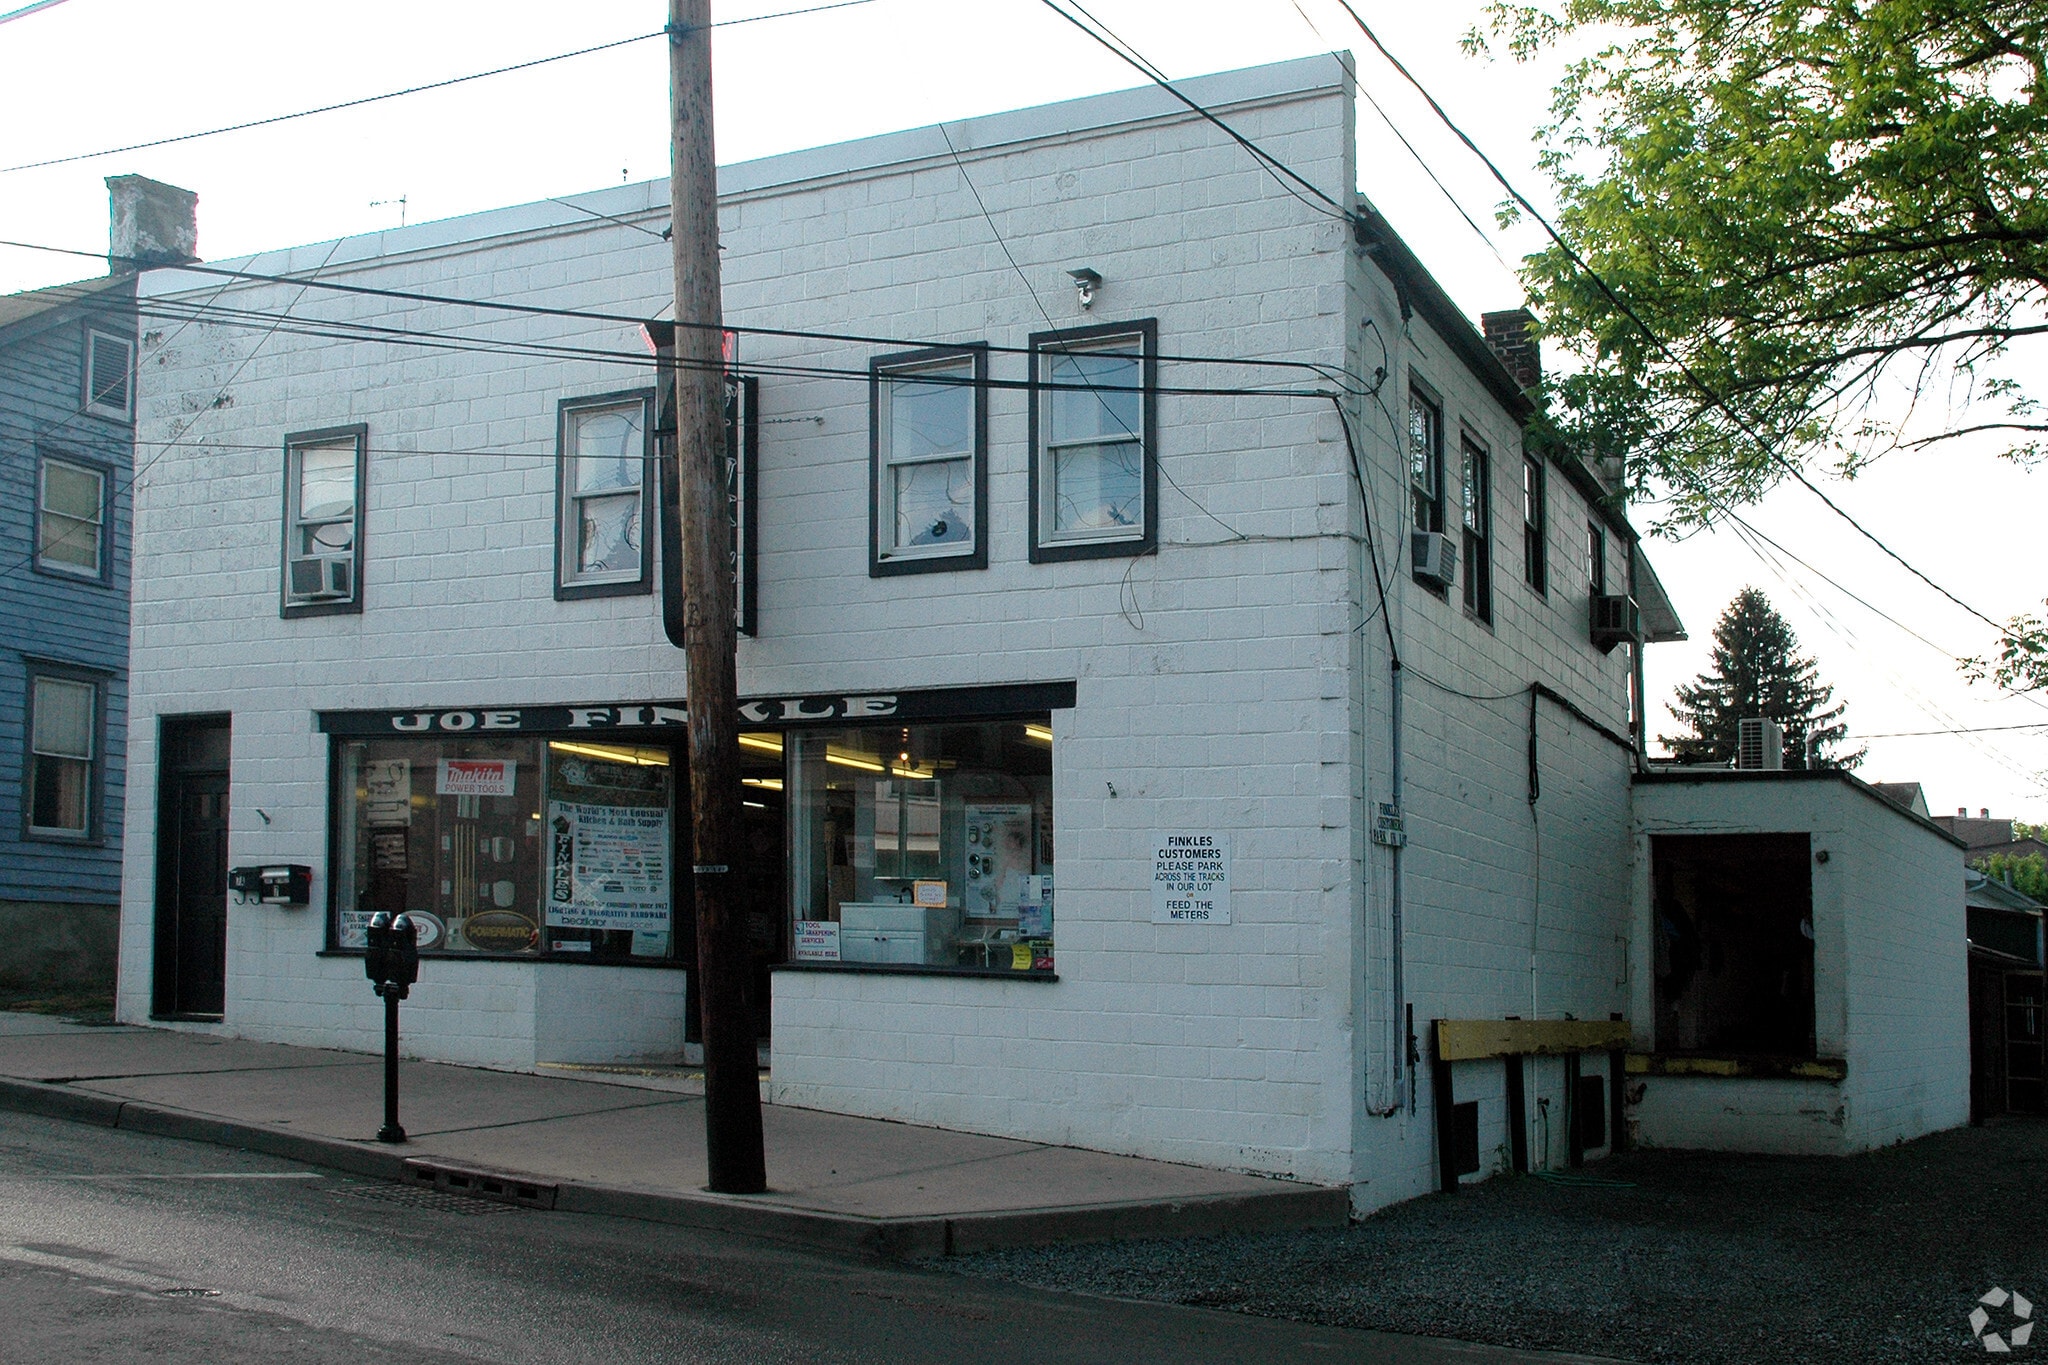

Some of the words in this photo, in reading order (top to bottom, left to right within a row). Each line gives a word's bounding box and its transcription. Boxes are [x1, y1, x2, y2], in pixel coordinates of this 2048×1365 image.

[392, 710, 521, 731] JOE
[448, 767, 502, 784] Makita
[444, 783, 475, 793] POWER
[477, 784, 505, 794] TOOLS
[559, 803, 573, 813] The
[608, 808, 627, 817] Most
[578, 815, 607, 825] Kitchen
[617, 818, 636, 826] Bath
[637, 819, 663, 828] Supply
[1168, 836, 1213, 846] FINKLES
[1373, 829, 1387, 843] PARK
[1158, 849, 1221, 859] CUSTOMERS
[554, 834, 570, 900] FINKLES
[1156, 861, 1194, 871] PLEASE
[1197, 861, 1223, 871] PARK
[1155, 872, 1181, 881] ACROSS
[1183, 872, 1196, 881] THE
[1199, 872, 1225, 881] TRACKS
[1166, 882, 1174, 891] IN
[1177, 882, 1195, 891] OUR
[1197, 882, 1213, 891] LOT
[1166, 900, 1191, 909] FEED
[1195, 900, 1213, 909] THE
[588, 909, 628, 918] DECORATIVE
[630, 911, 667, 919] HARDWARE
[1170, 910, 1209, 919] METERS
[470, 926, 530, 938] POWERMATIC
